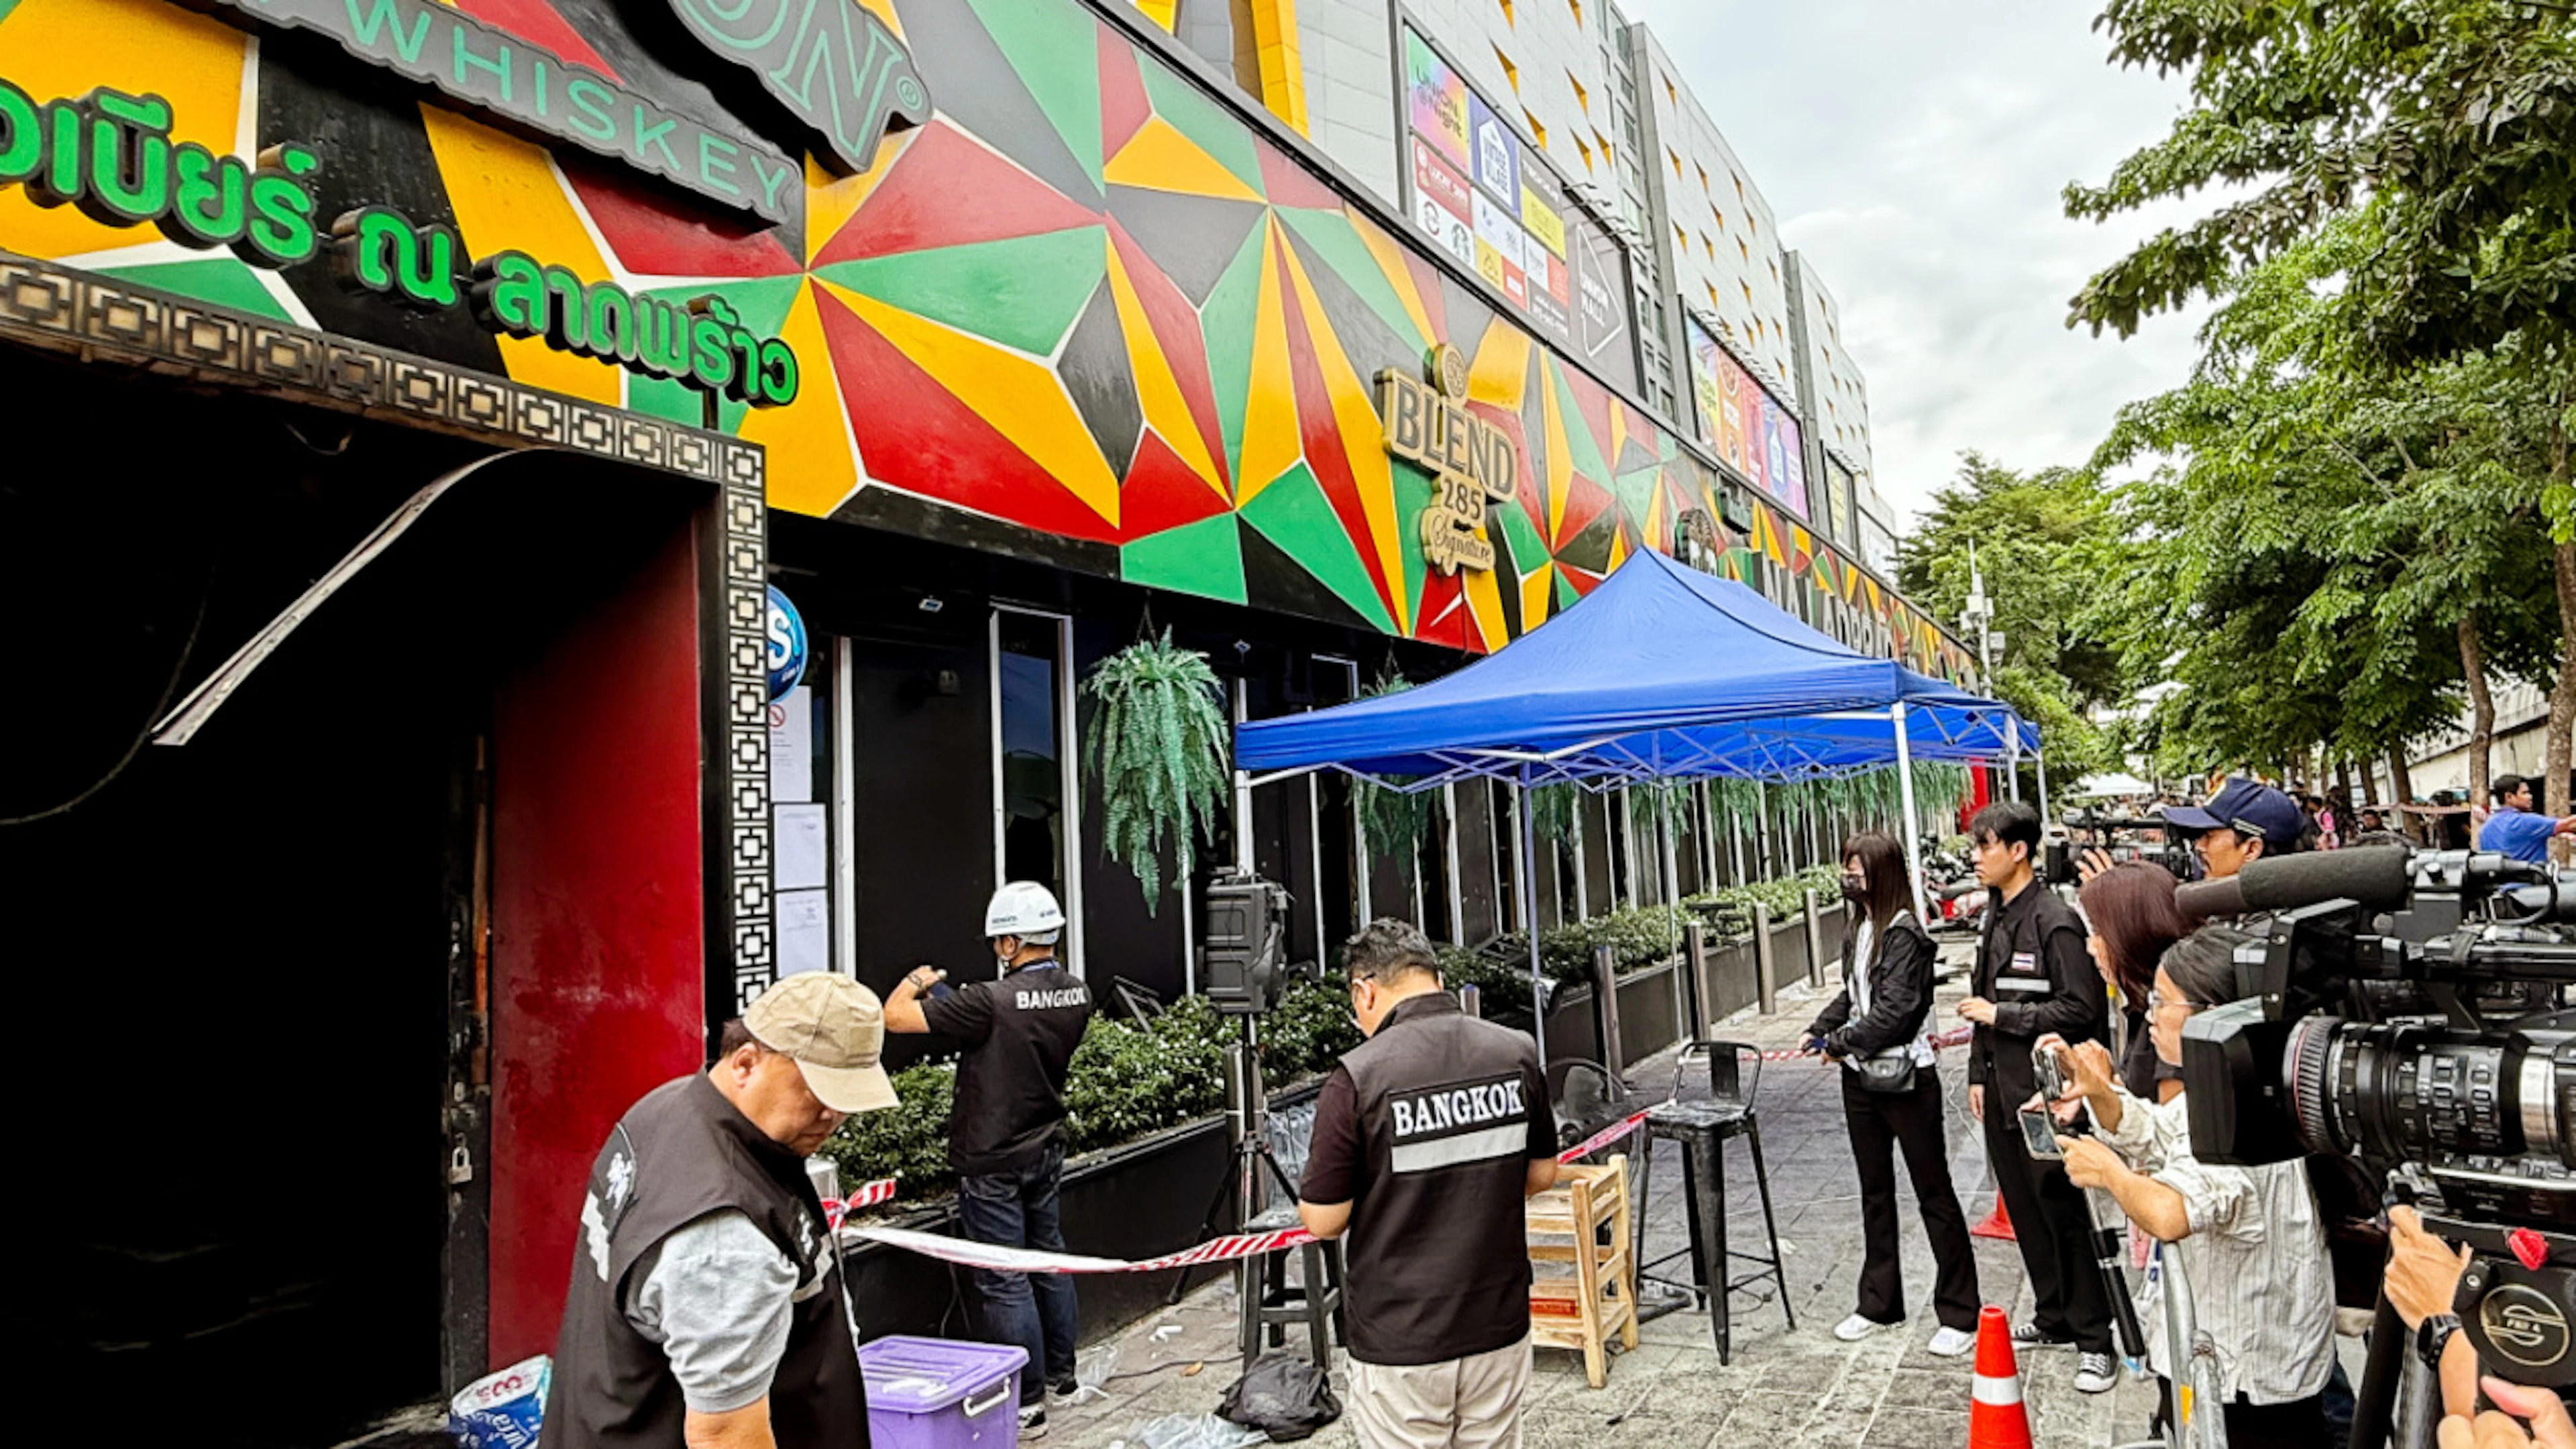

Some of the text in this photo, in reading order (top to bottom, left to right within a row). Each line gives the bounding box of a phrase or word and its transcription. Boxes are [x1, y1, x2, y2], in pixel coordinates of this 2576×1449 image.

[343, 0, 786, 209] WHISKEY
[358, 211, 459, 307] ณ
[492, 254, 798, 405] ลาดพร้าว
[1395, 380, 1514, 496] BLEND
[1442, 477, 1482, 521] 285
[1391, 1079, 1525, 1138] BANGKOK
